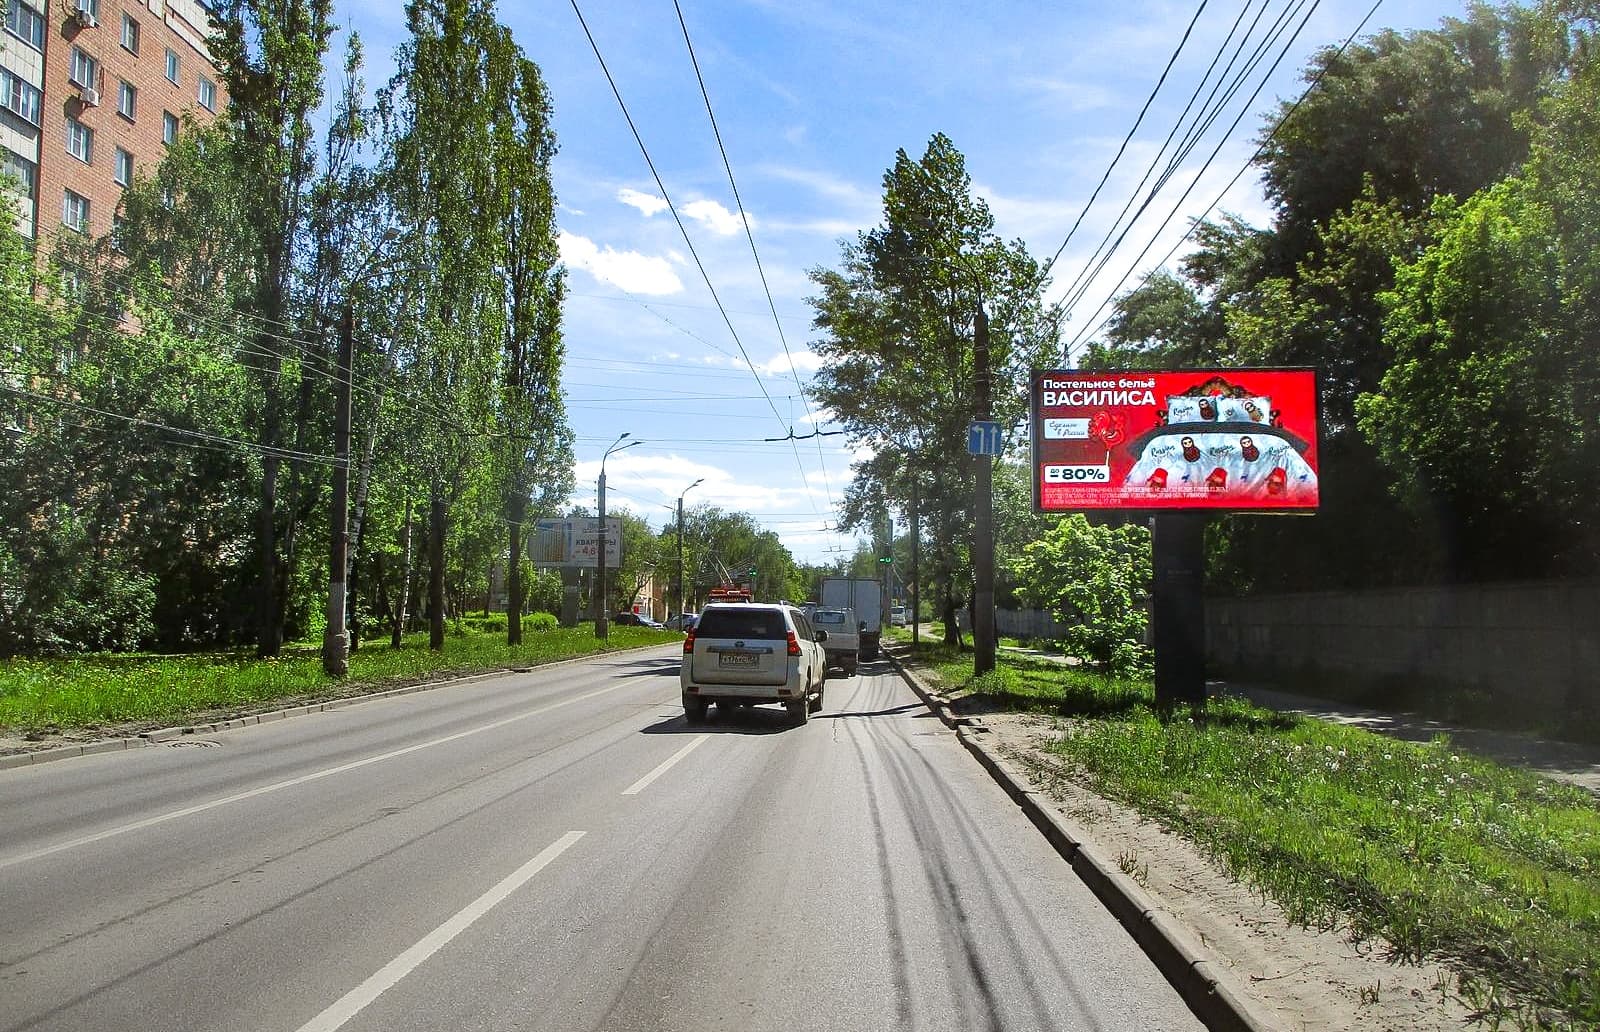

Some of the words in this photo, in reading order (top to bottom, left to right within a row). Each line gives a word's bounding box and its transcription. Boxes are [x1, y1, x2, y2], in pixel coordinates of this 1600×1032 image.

[1043, 380, 1116, 389] Постельное
[1118, 378, 1155, 388] бельё
[1043, 390, 1156, 406] ВАСИЛИСА
